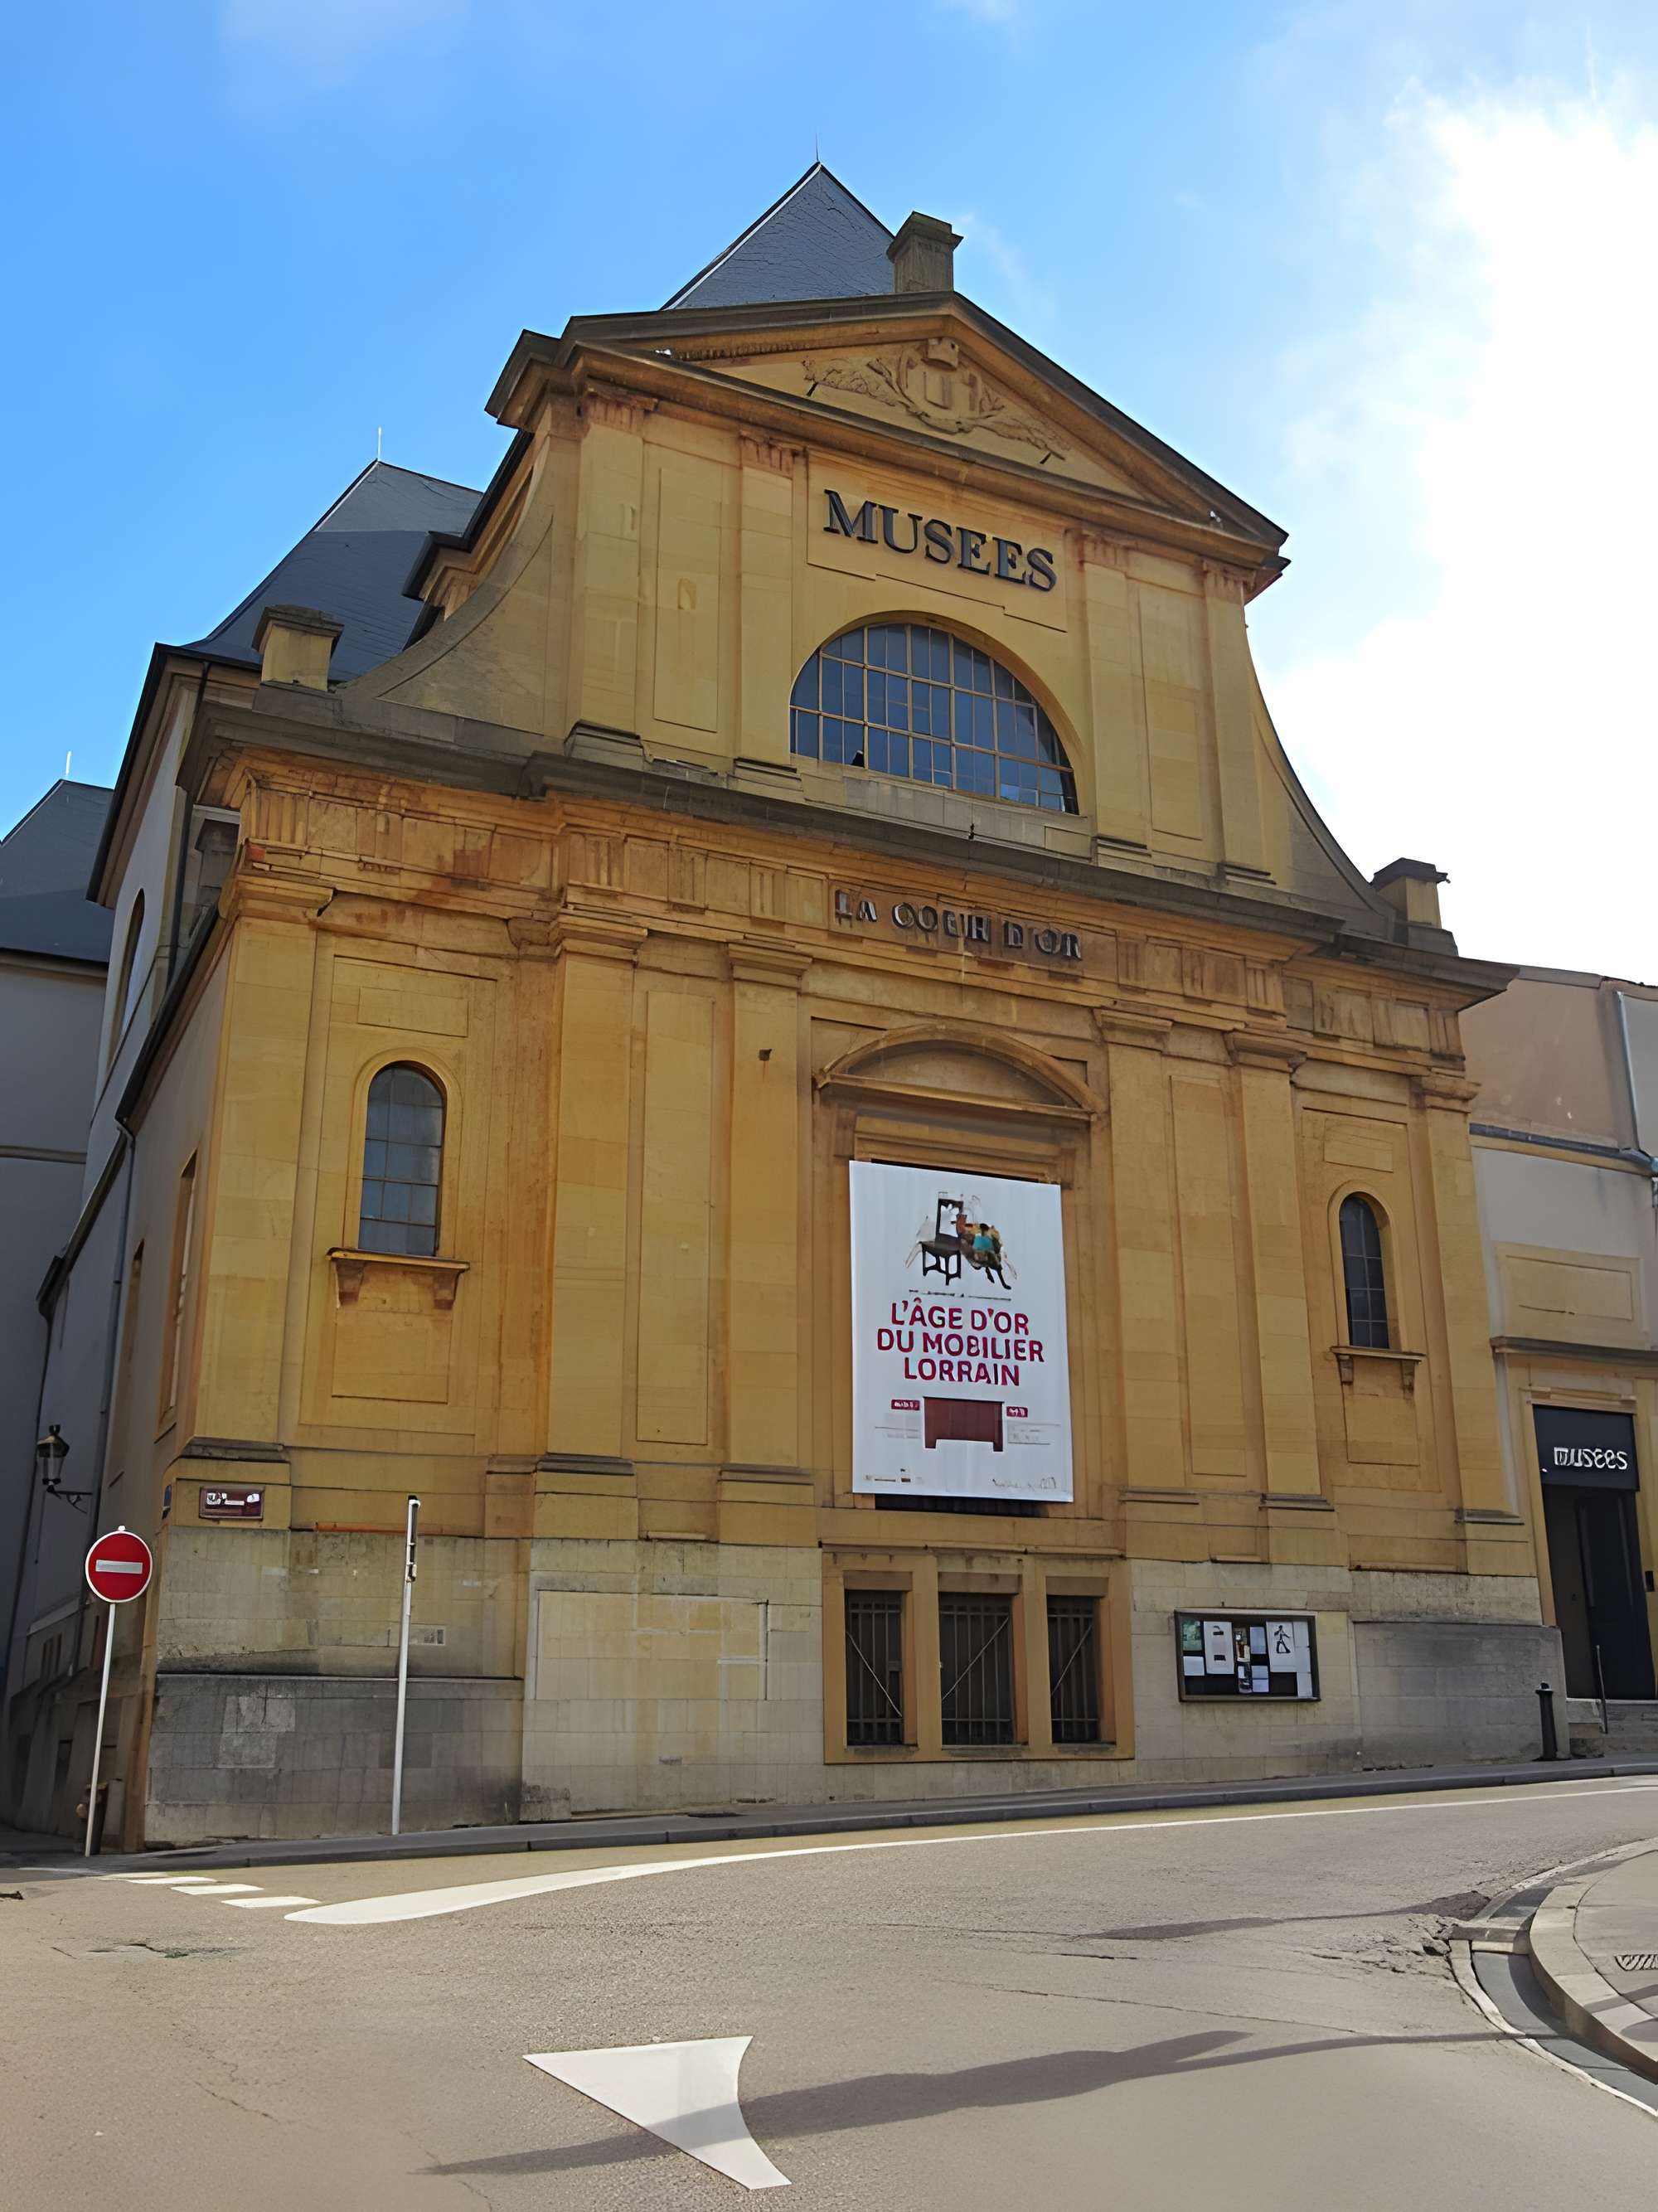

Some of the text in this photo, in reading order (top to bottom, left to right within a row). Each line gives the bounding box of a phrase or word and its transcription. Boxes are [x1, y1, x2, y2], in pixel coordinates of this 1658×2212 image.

[822, 488, 1058, 592] MUSEES
[890, 1297, 1030, 1336] L'ÂGE D'OR
[876, 1327, 1045, 1362] DU MOBILIER
[903, 1356, 1020, 1387] LORRAIN
